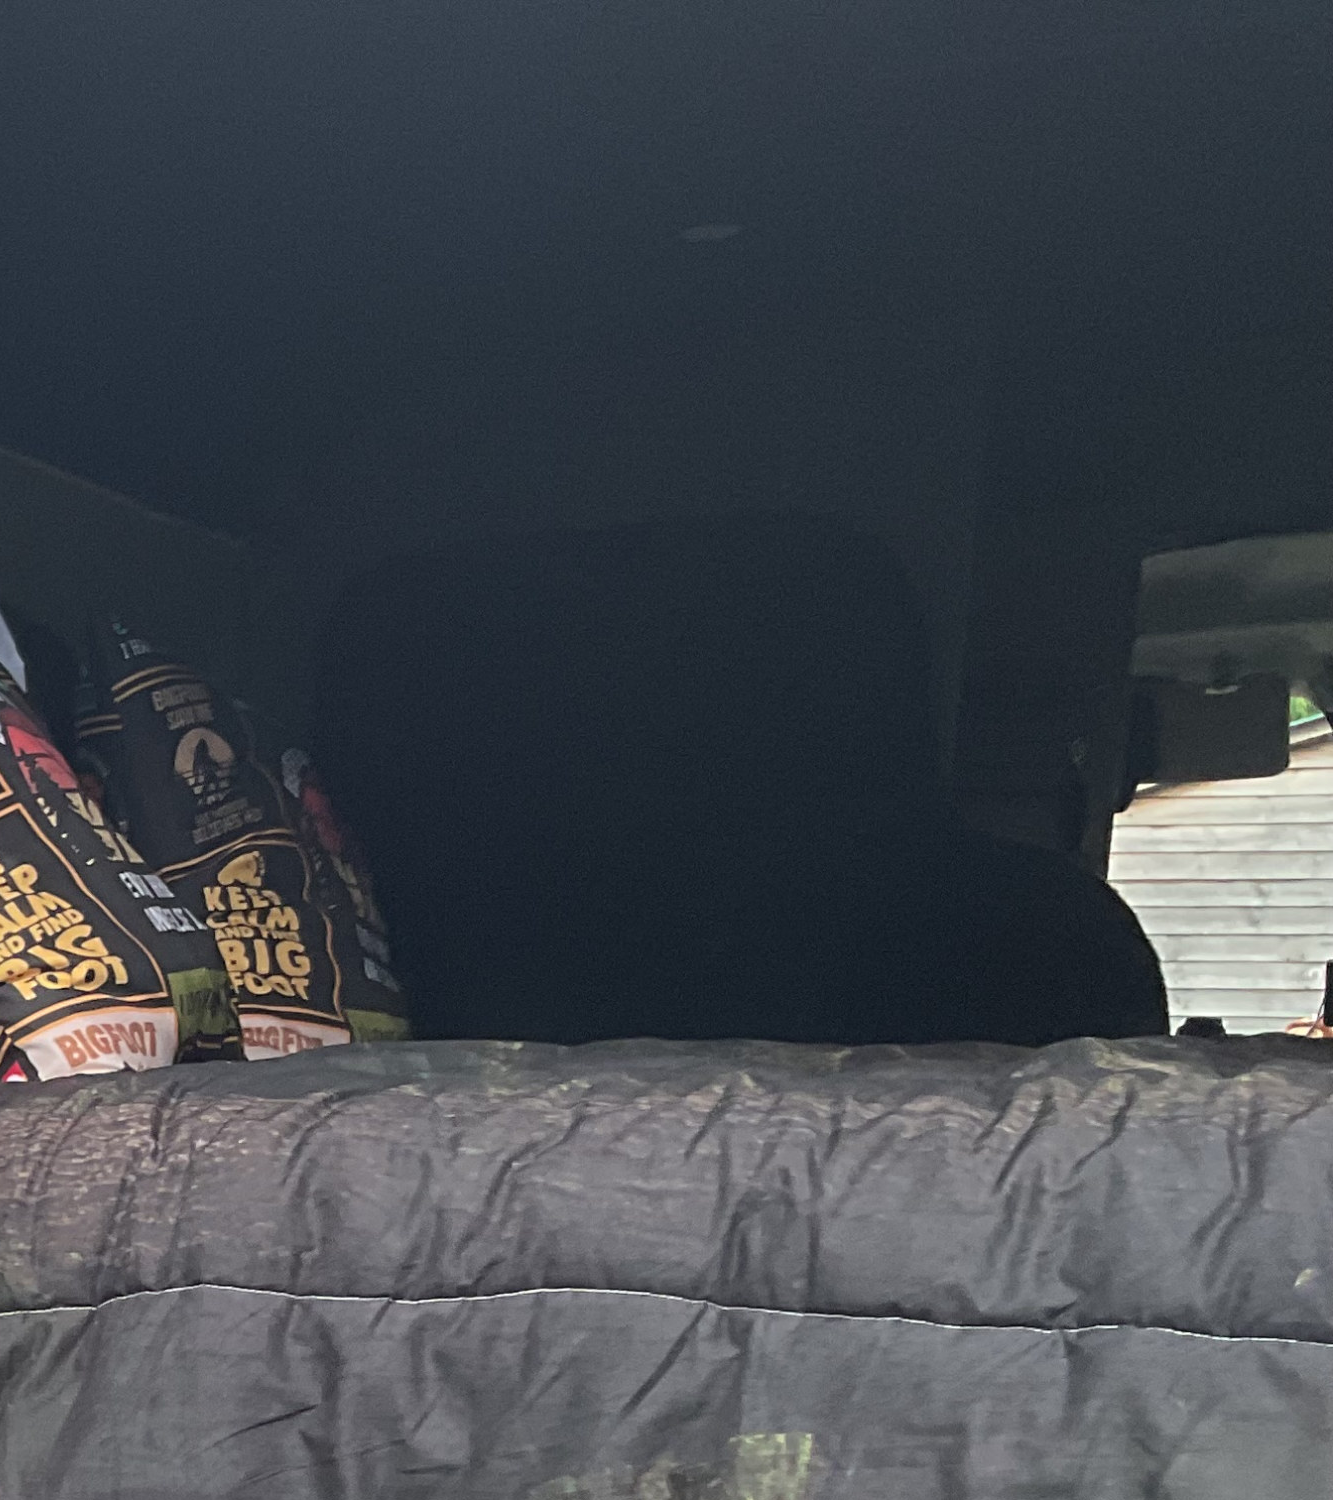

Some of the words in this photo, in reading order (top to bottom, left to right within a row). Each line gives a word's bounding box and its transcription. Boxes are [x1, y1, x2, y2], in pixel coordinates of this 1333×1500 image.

[31, 909, 85, 942] FIND
[215, 926, 254, 940] AND
[217, 939, 311, 977] BIG
[13, 955, 129, 1001] FOOT
[228, 971, 310, 1001] FOOT
[53, 1021, 158, 1070] BIGFOOT
